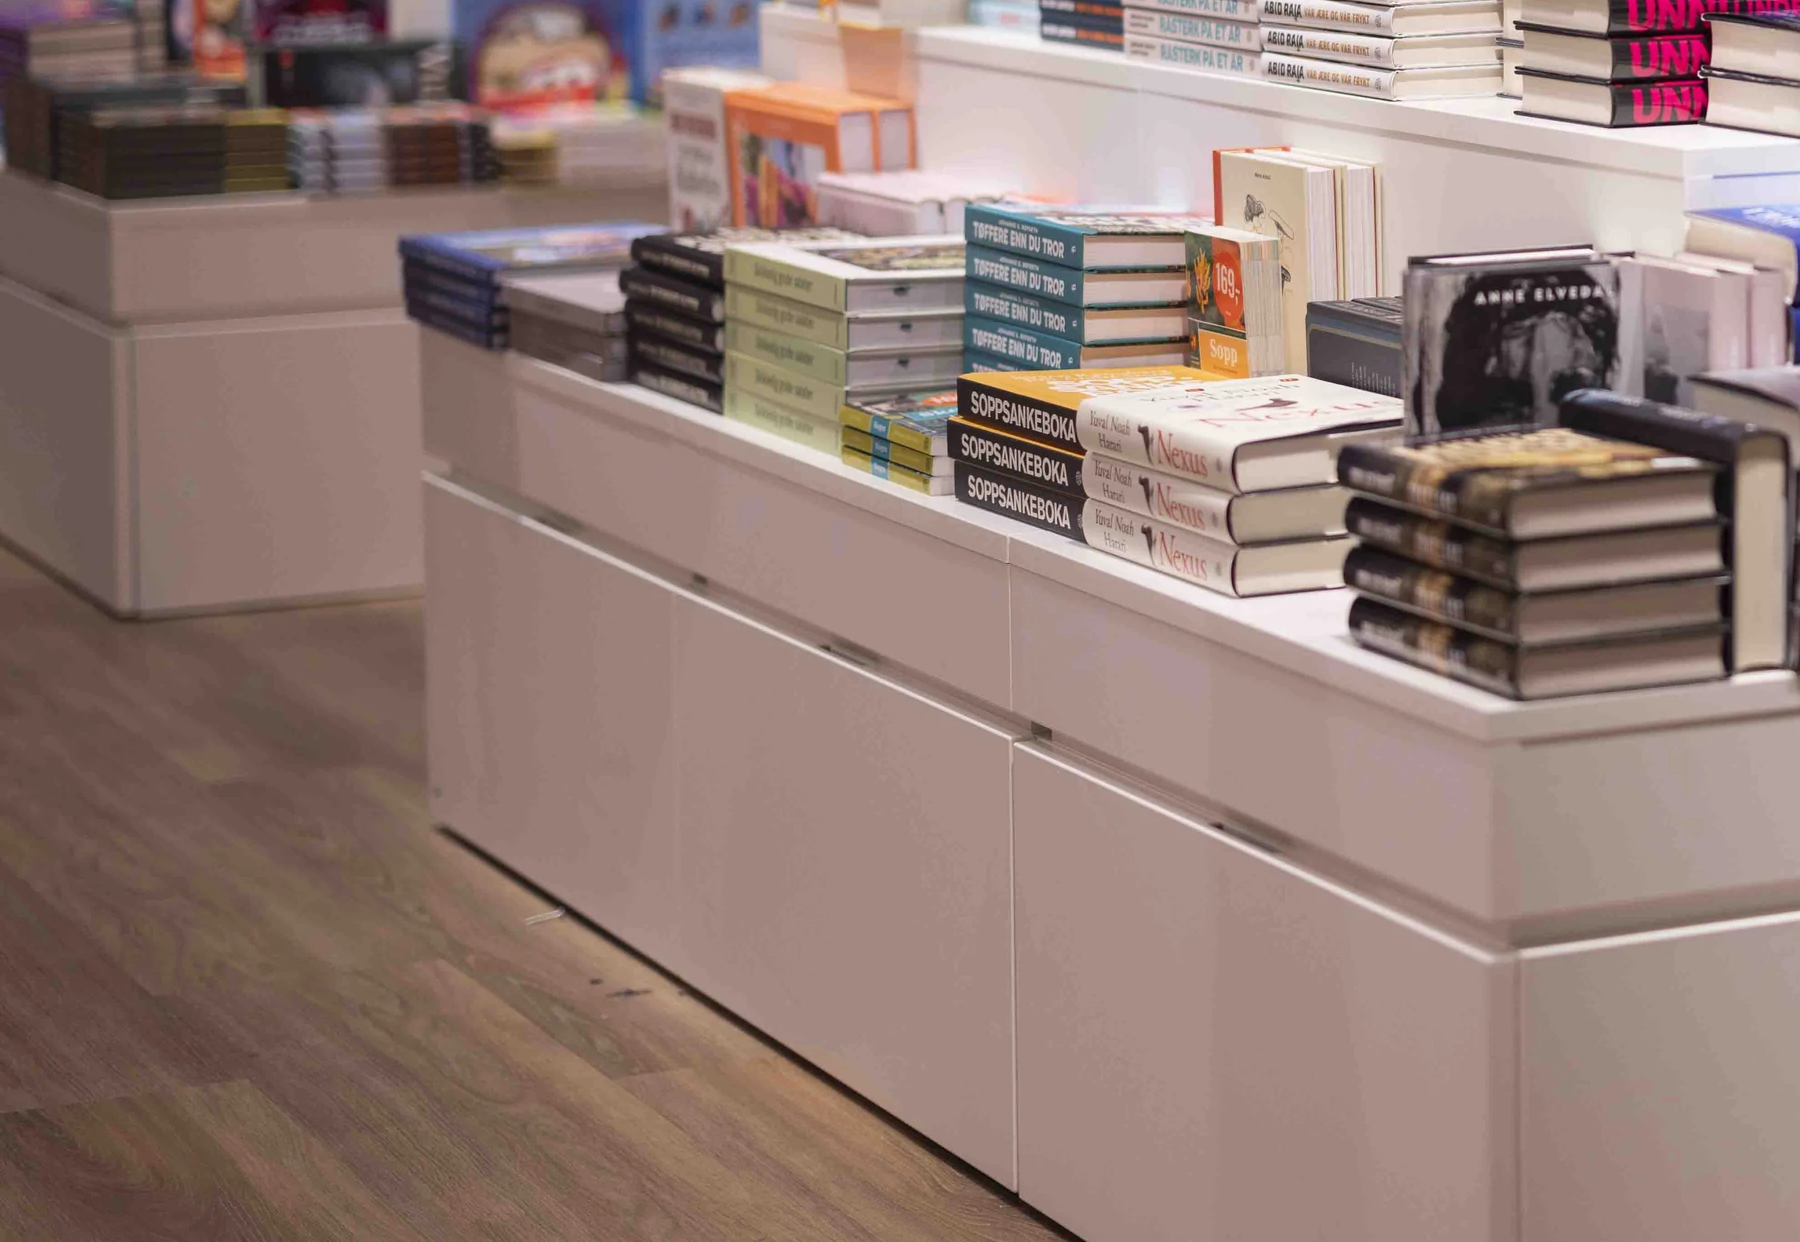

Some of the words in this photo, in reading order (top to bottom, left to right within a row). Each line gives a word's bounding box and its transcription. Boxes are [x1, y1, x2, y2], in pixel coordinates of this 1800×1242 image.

[1629, 41, 1712, 77] UNN
[973, 221, 1009, 245] TØFFERE
[1010, 229, 1027, 249] ENN
[1028, 234, 1041, 252] DU
[1042, 237, 1065, 258] TROR
[1215, 261, 1241, 306] 169,-
[1474, 288, 1525, 305] ANNE
[1209, 337, 1238, 367] Sopp
[971, 391, 1077, 443] SOPPSANKEBOKA
[1090, 410, 1109, 431] Yuval
[1110, 415, 1131, 437] Noah
[961, 433, 1068, 487] SOPPSANKEBOKA
[1157, 429, 1208, 477] Nexus
[968, 475, 1071, 530] SOPPSANKEBOKA
[1157, 482, 1206, 531] Nexus
[1159, 531, 1208, 581] Nexus
